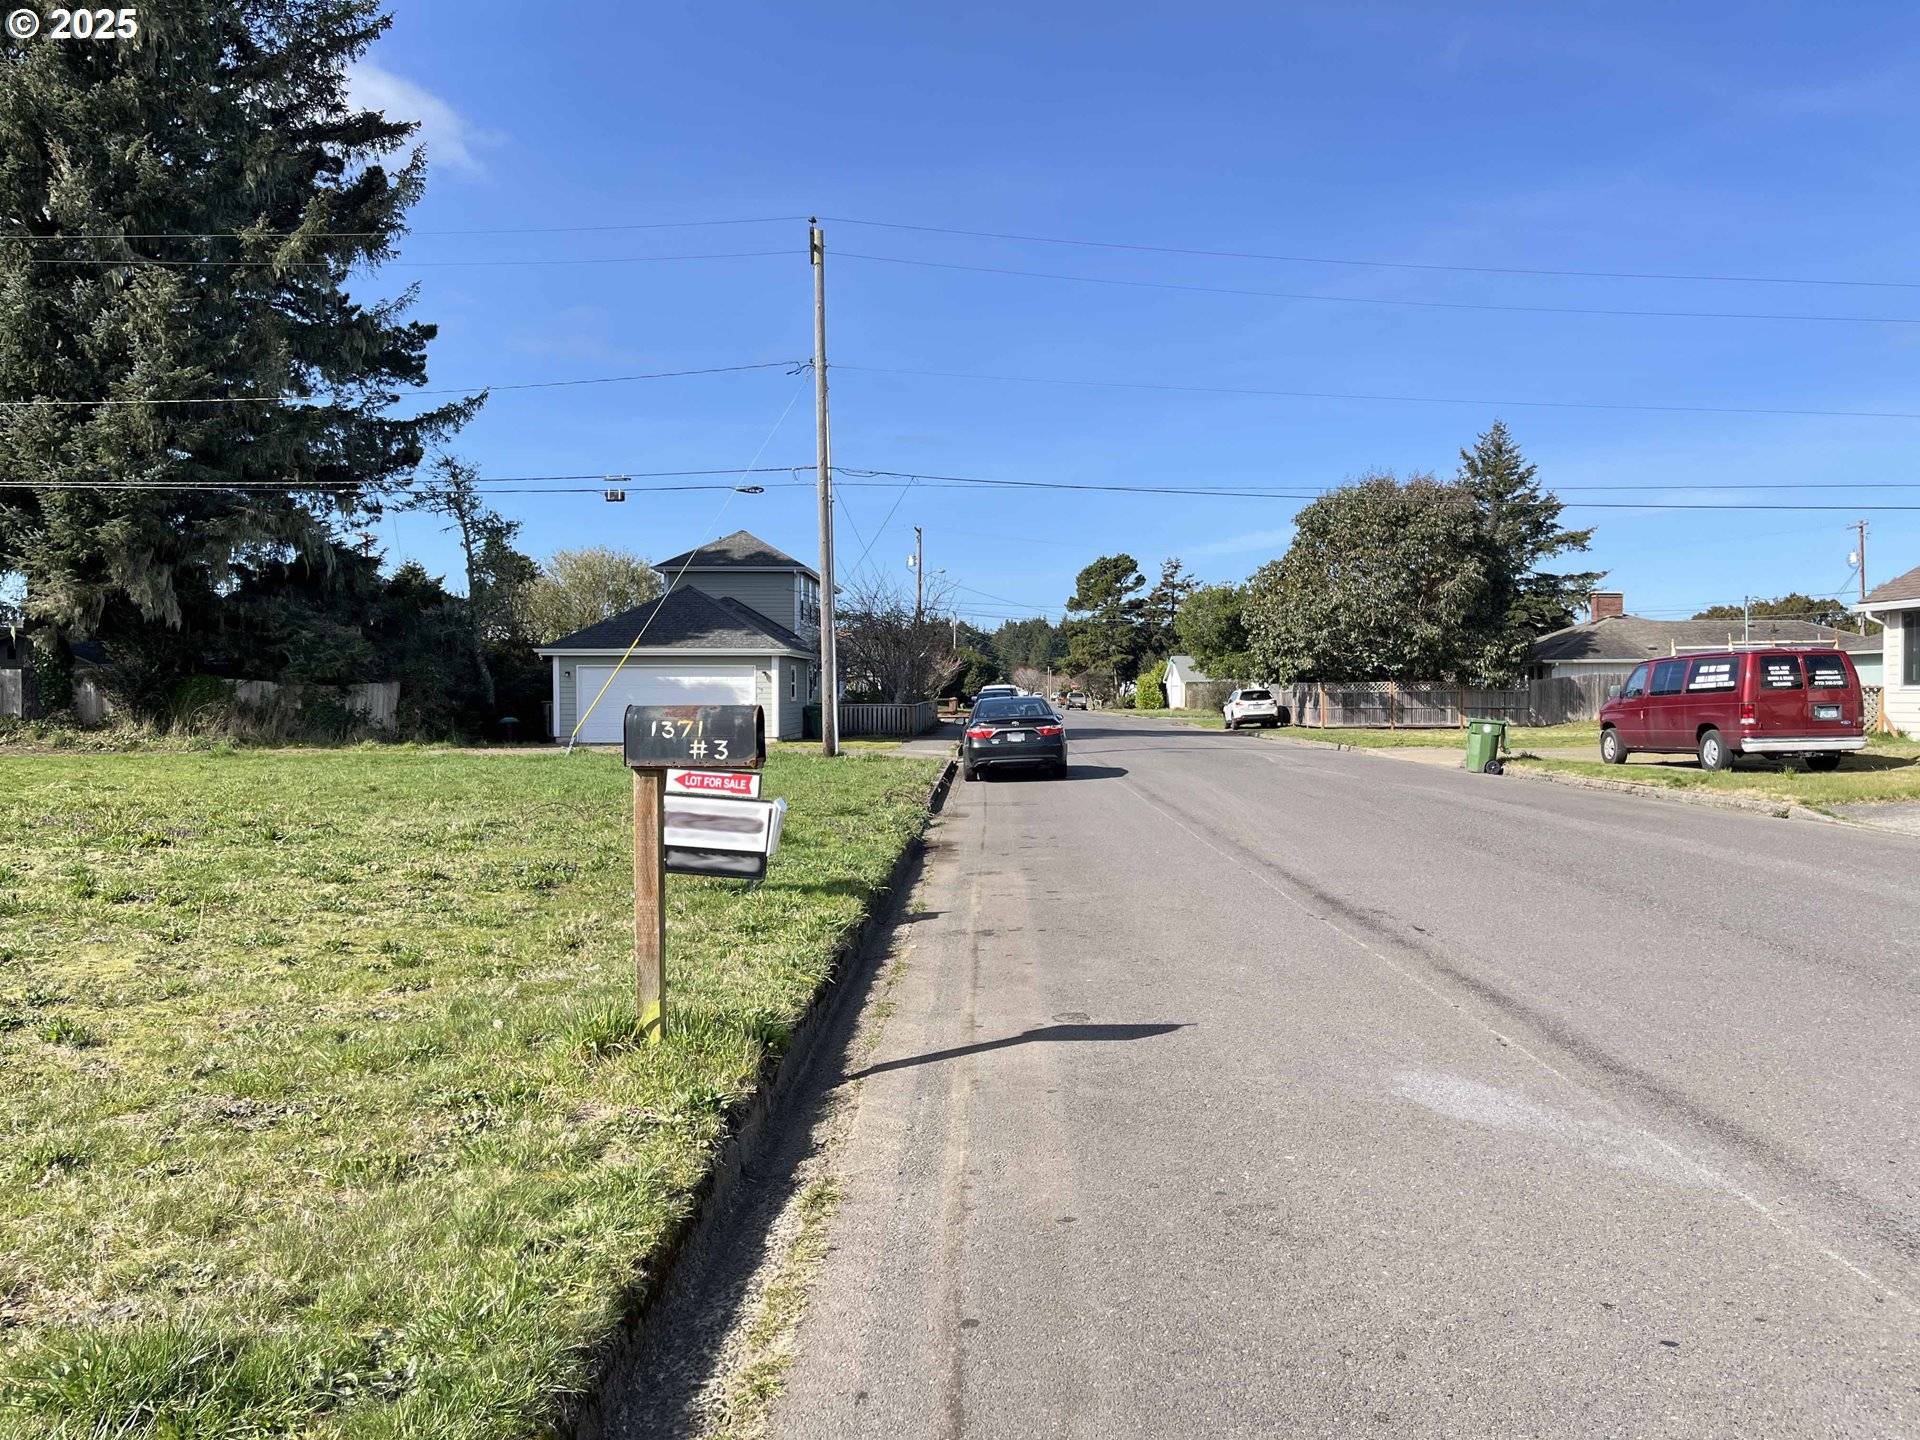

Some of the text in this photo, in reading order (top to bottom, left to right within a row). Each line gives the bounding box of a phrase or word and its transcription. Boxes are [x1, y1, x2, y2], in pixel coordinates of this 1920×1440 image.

[651, 720, 703, 739] 1371
[684, 775, 747, 790] LOT FOR SALE
